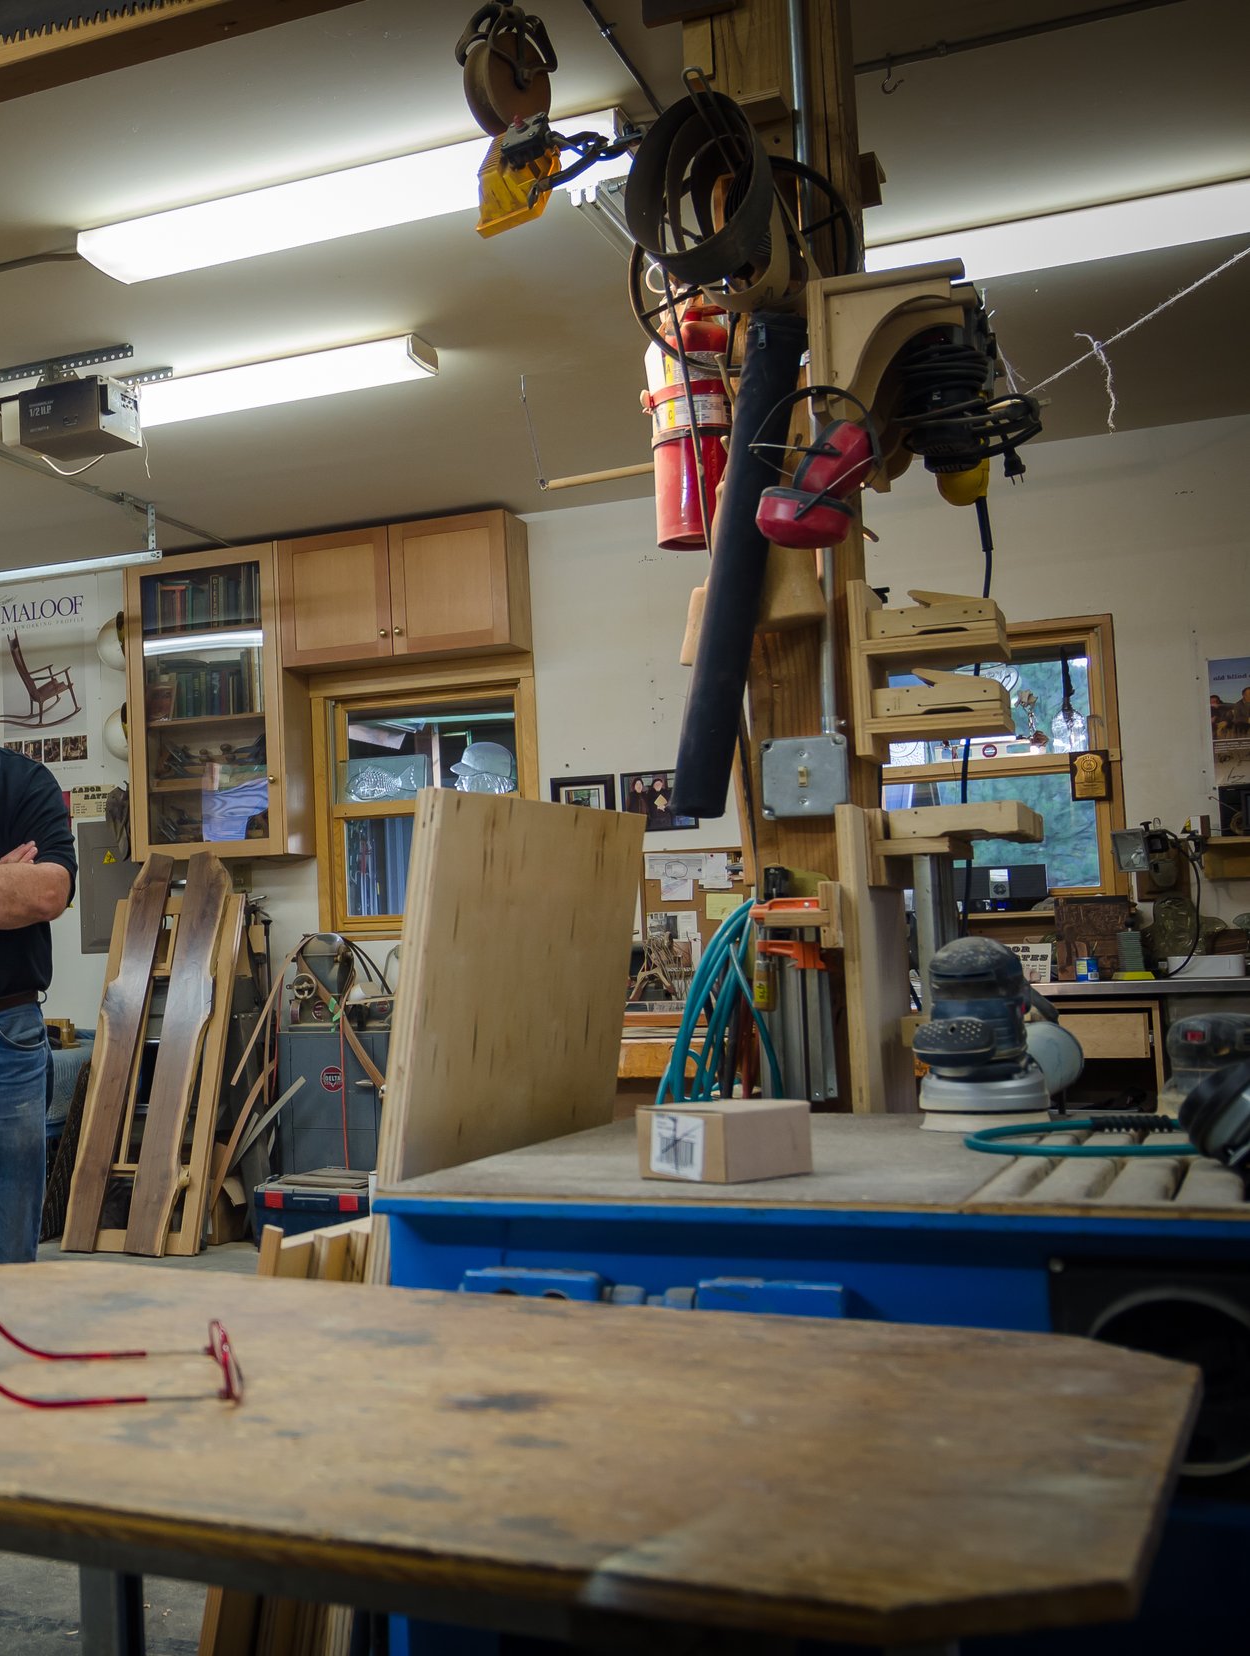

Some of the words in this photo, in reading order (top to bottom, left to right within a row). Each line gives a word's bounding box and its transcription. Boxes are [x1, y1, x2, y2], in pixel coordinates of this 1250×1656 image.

[0, 595, 84, 624] MALOOF
[1, 621, 52, 631] WOODWORKING
[56, 617, 84, 625] PROFILE
